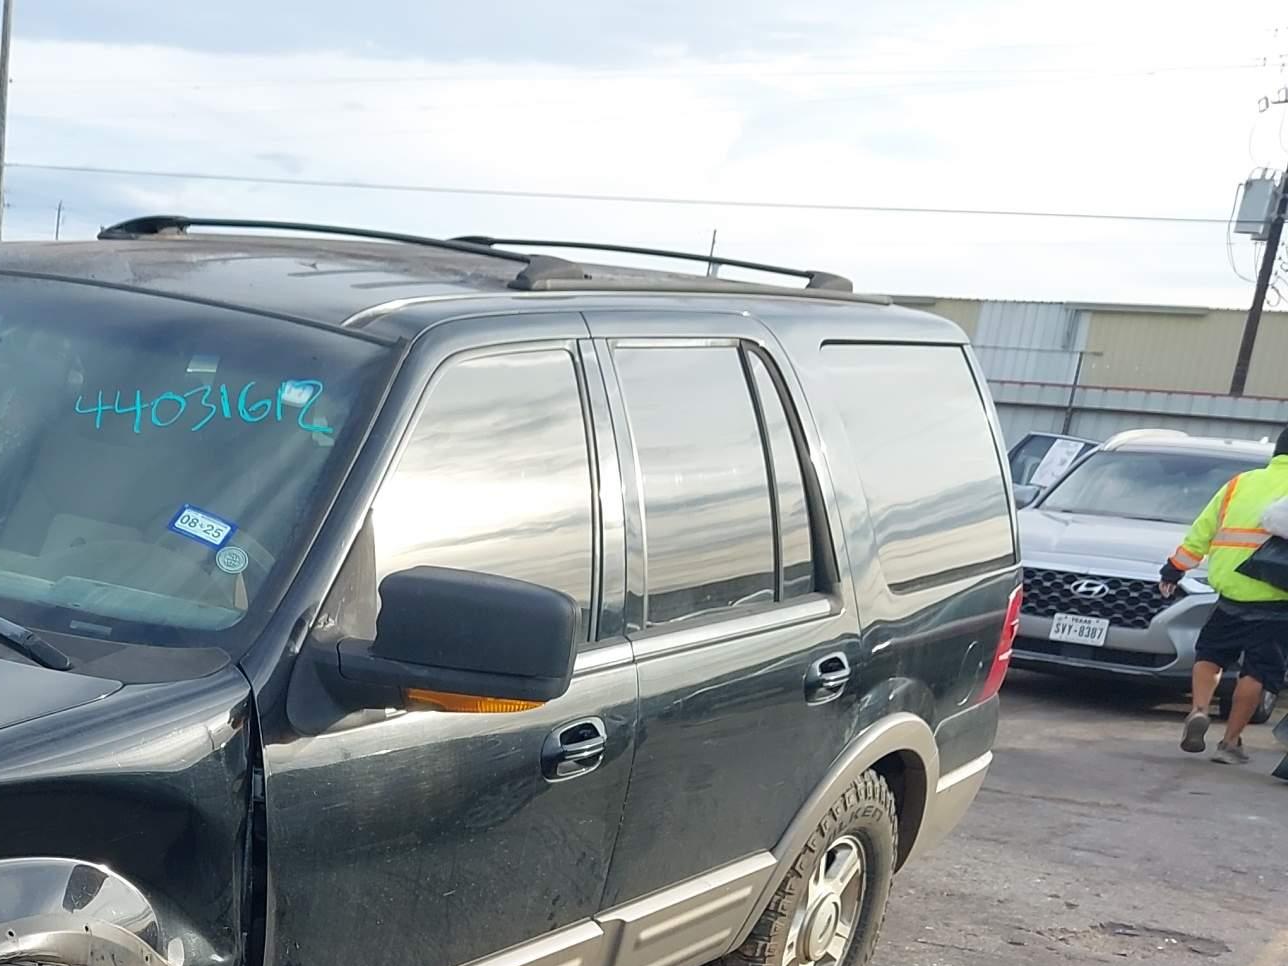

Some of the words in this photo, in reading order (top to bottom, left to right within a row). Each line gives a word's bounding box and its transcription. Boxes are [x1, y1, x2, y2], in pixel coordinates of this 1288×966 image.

[74, 379, 333, 433] 44031612
[179, 514, 199, 528] 08
[203, 524, 223, 538] 25
